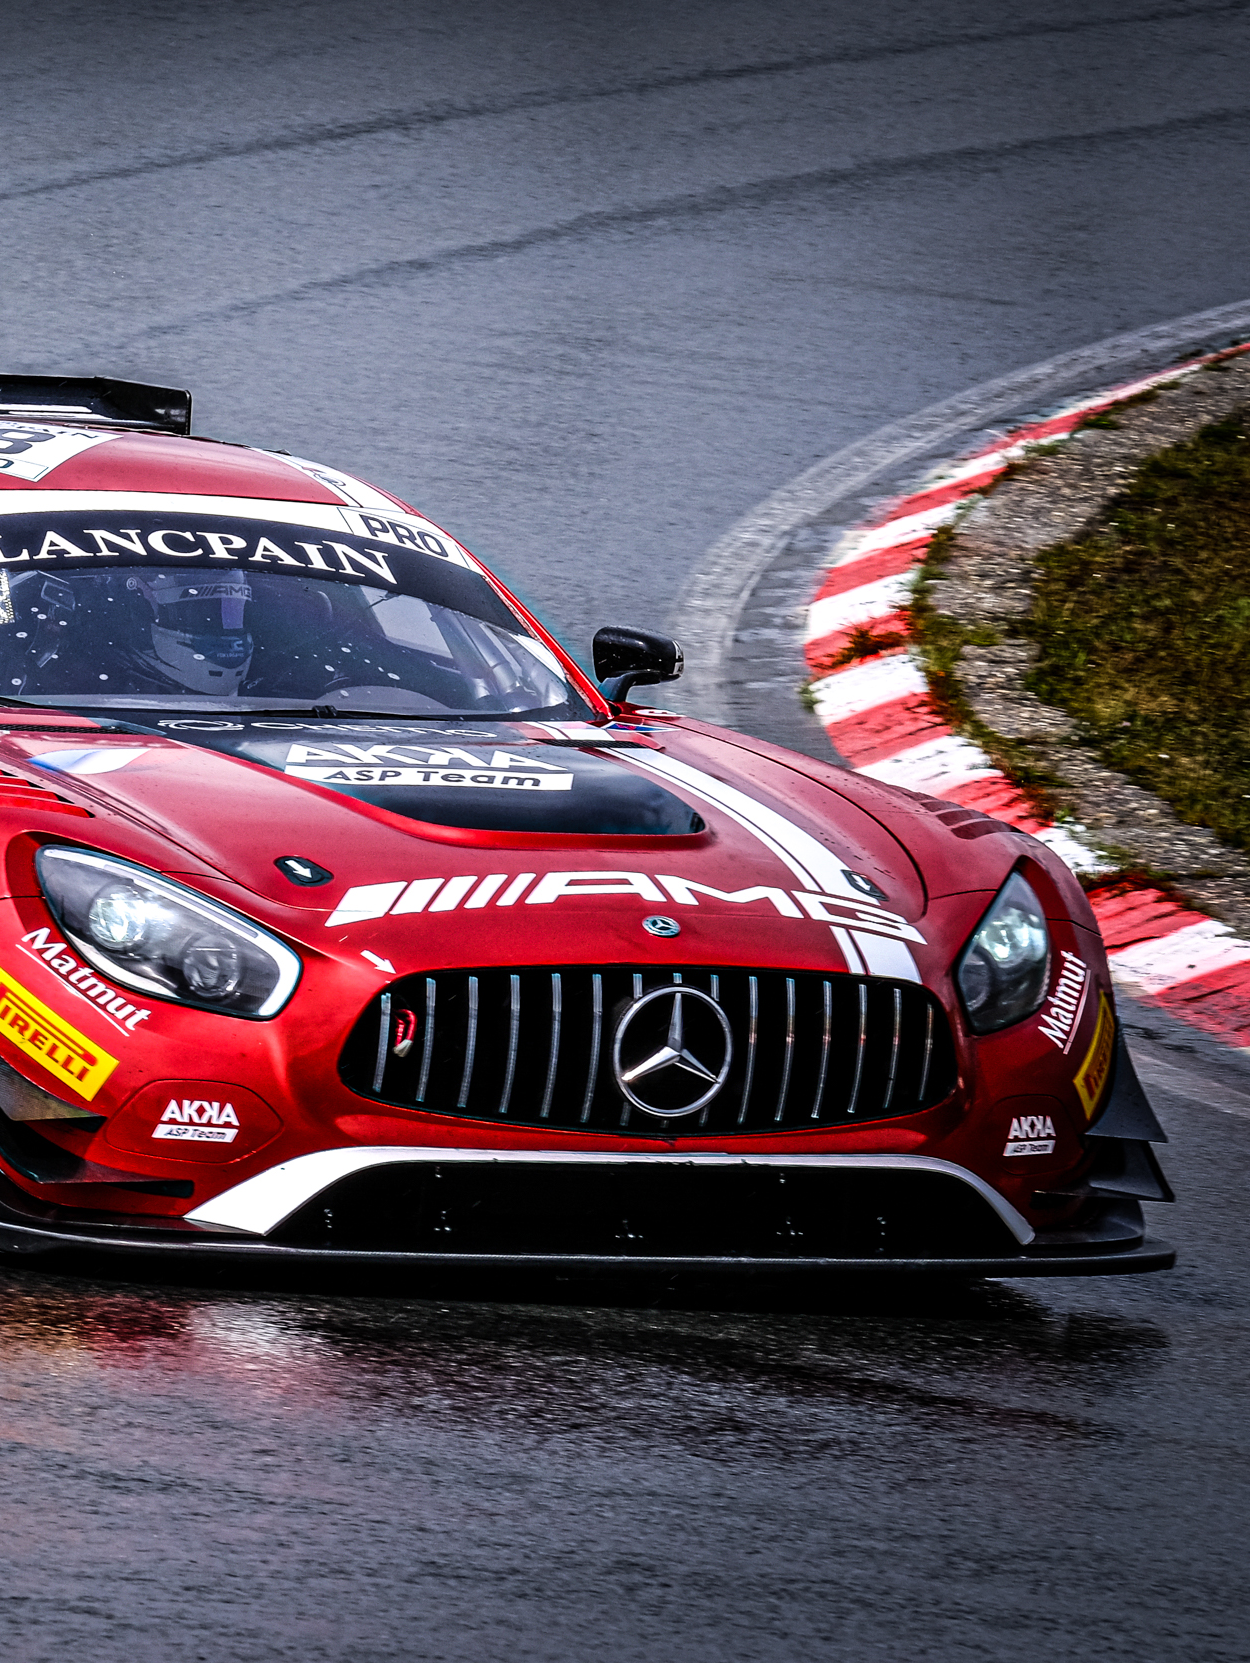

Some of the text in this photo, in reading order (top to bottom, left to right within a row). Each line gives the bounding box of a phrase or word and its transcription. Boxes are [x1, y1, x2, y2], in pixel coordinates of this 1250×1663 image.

[358, 513, 450, 559] PRO
[286, 743, 569, 772] AKKA
[324, 769, 542, 788] ASP Team
[525, 871, 928, 945] AMG
[21, 926, 152, 1032] Matmut
[1038, 950, 1088, 1050] Matmut
[160, 1098, 240, 1127] AKKA
[1007, 1114, 1057, 1140] AKKA
